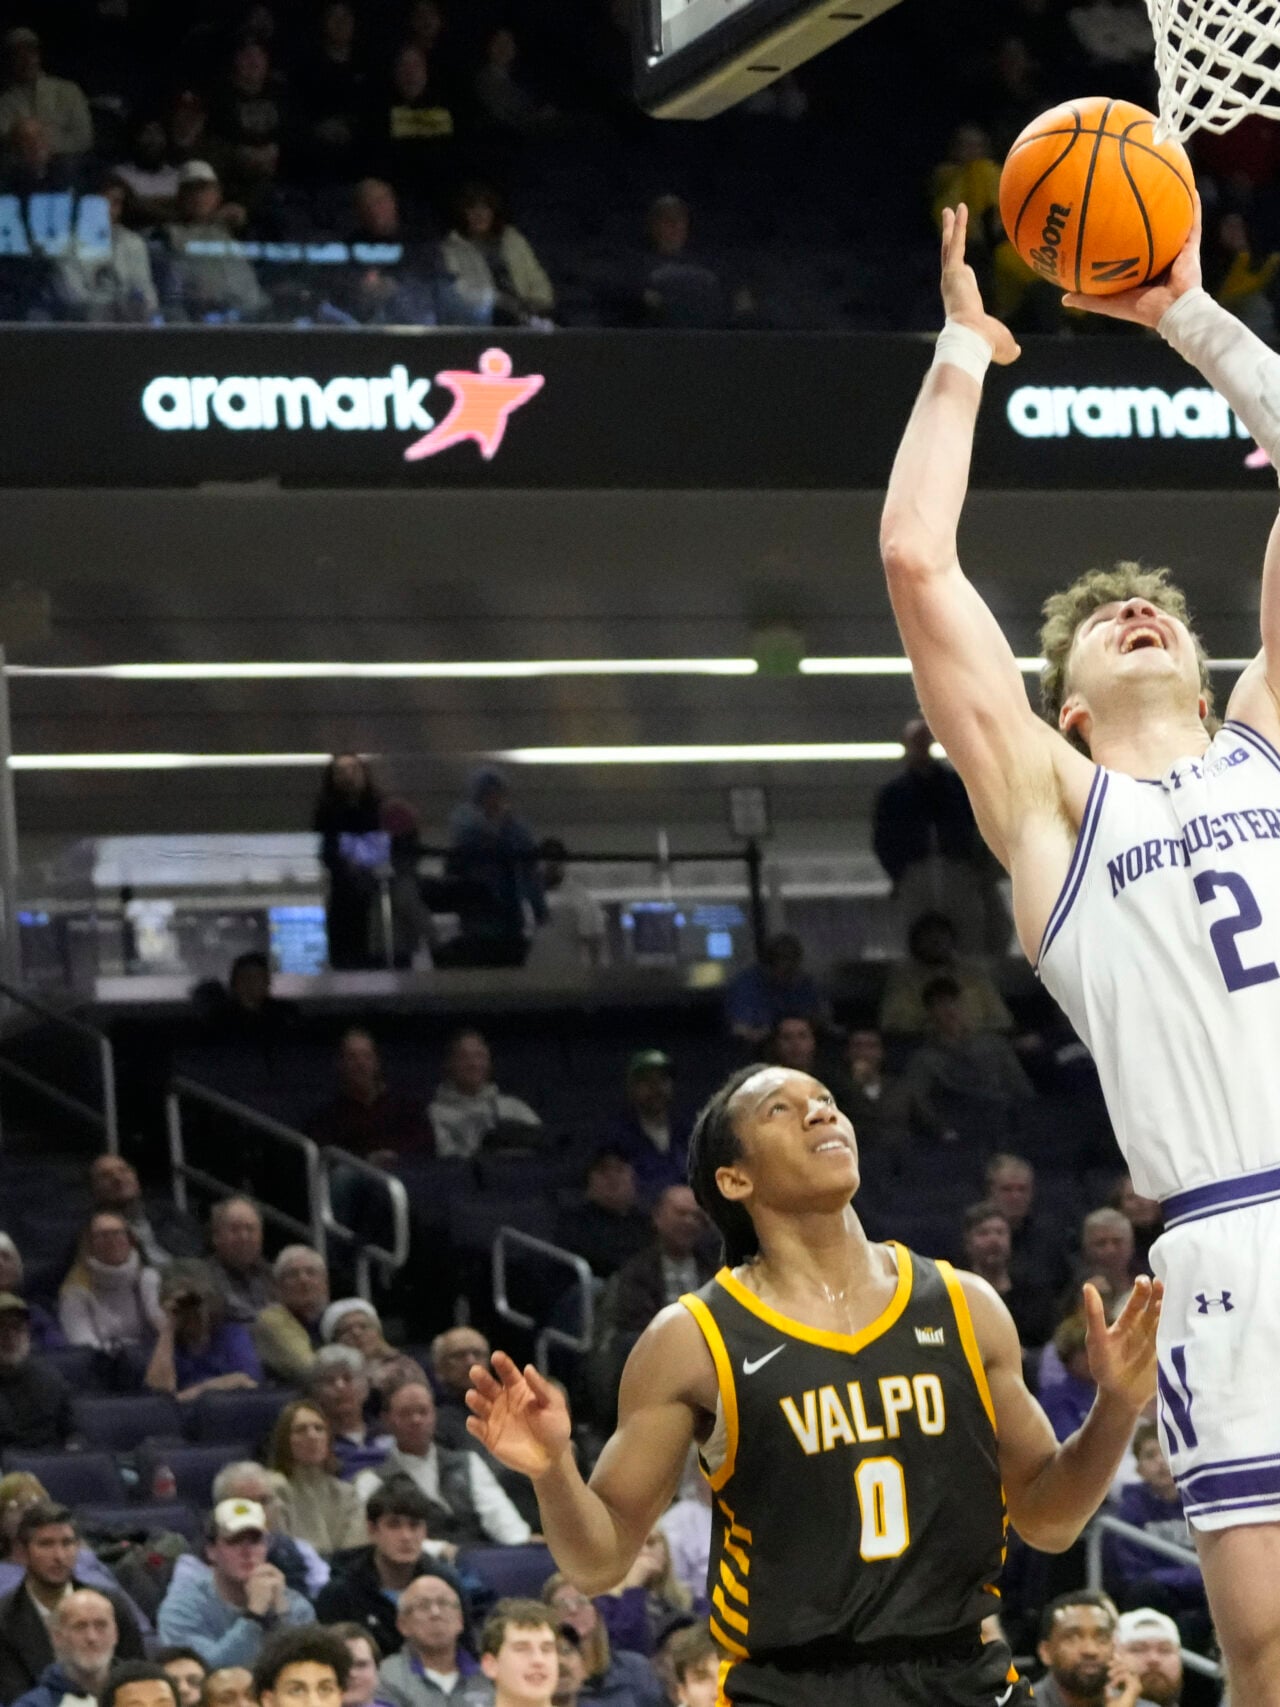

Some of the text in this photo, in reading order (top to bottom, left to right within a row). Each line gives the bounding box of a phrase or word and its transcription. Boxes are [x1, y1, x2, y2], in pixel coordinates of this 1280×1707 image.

[142, 364, 435, 430] aramark
[1007, 386, 1251, 439] aramar
[1193, 869, 1280, 992] 2
[779, 1373, 946, 1456] VALPO
[854, 1455, 910, 1562] 0
